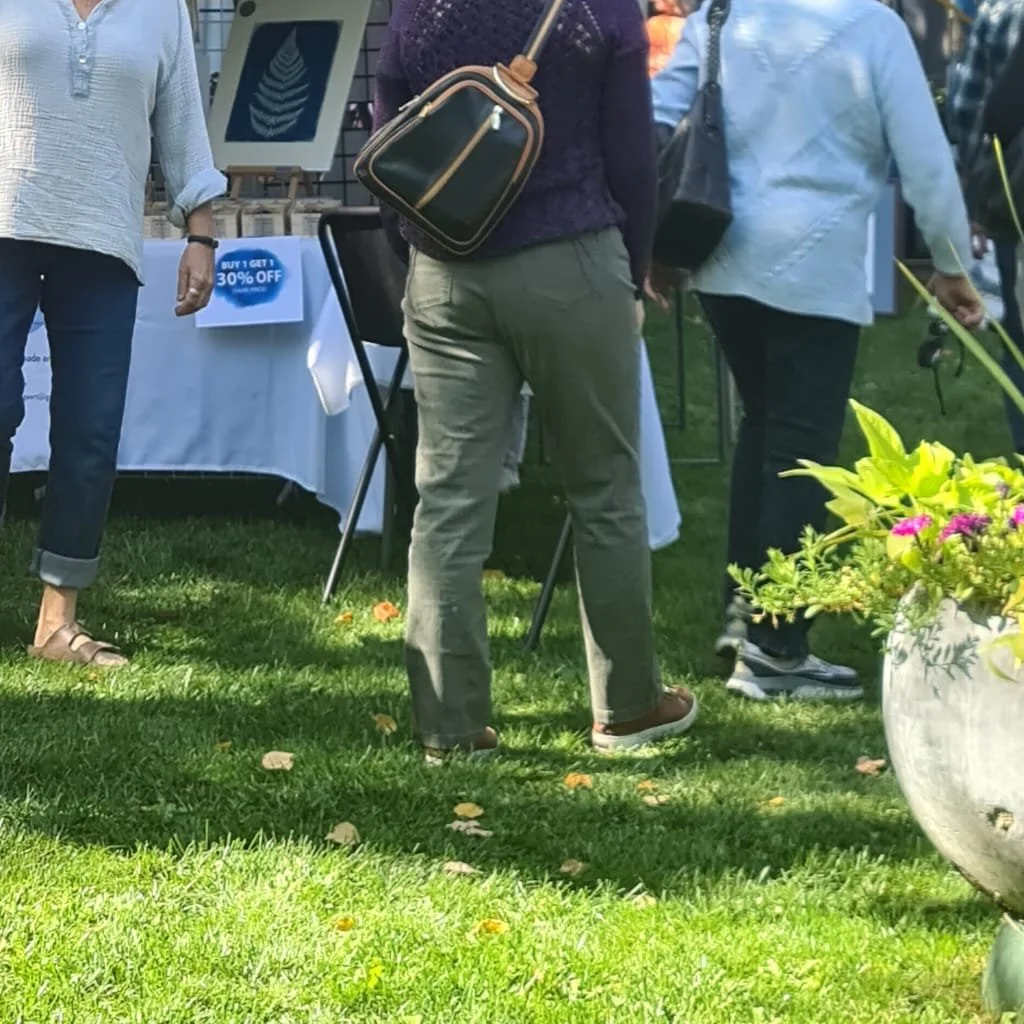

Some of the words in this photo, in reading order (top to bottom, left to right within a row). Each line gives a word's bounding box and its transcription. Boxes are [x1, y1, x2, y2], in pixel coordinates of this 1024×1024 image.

[221, 261, 241, 270] BUY
[242, 261, 248, 269] 1
[249, 259, 268, 268] GET
[269, 259, 274, 267] 1
[217, 271, 254, 286] 30%
[256, 270, 282, 284] OFF
